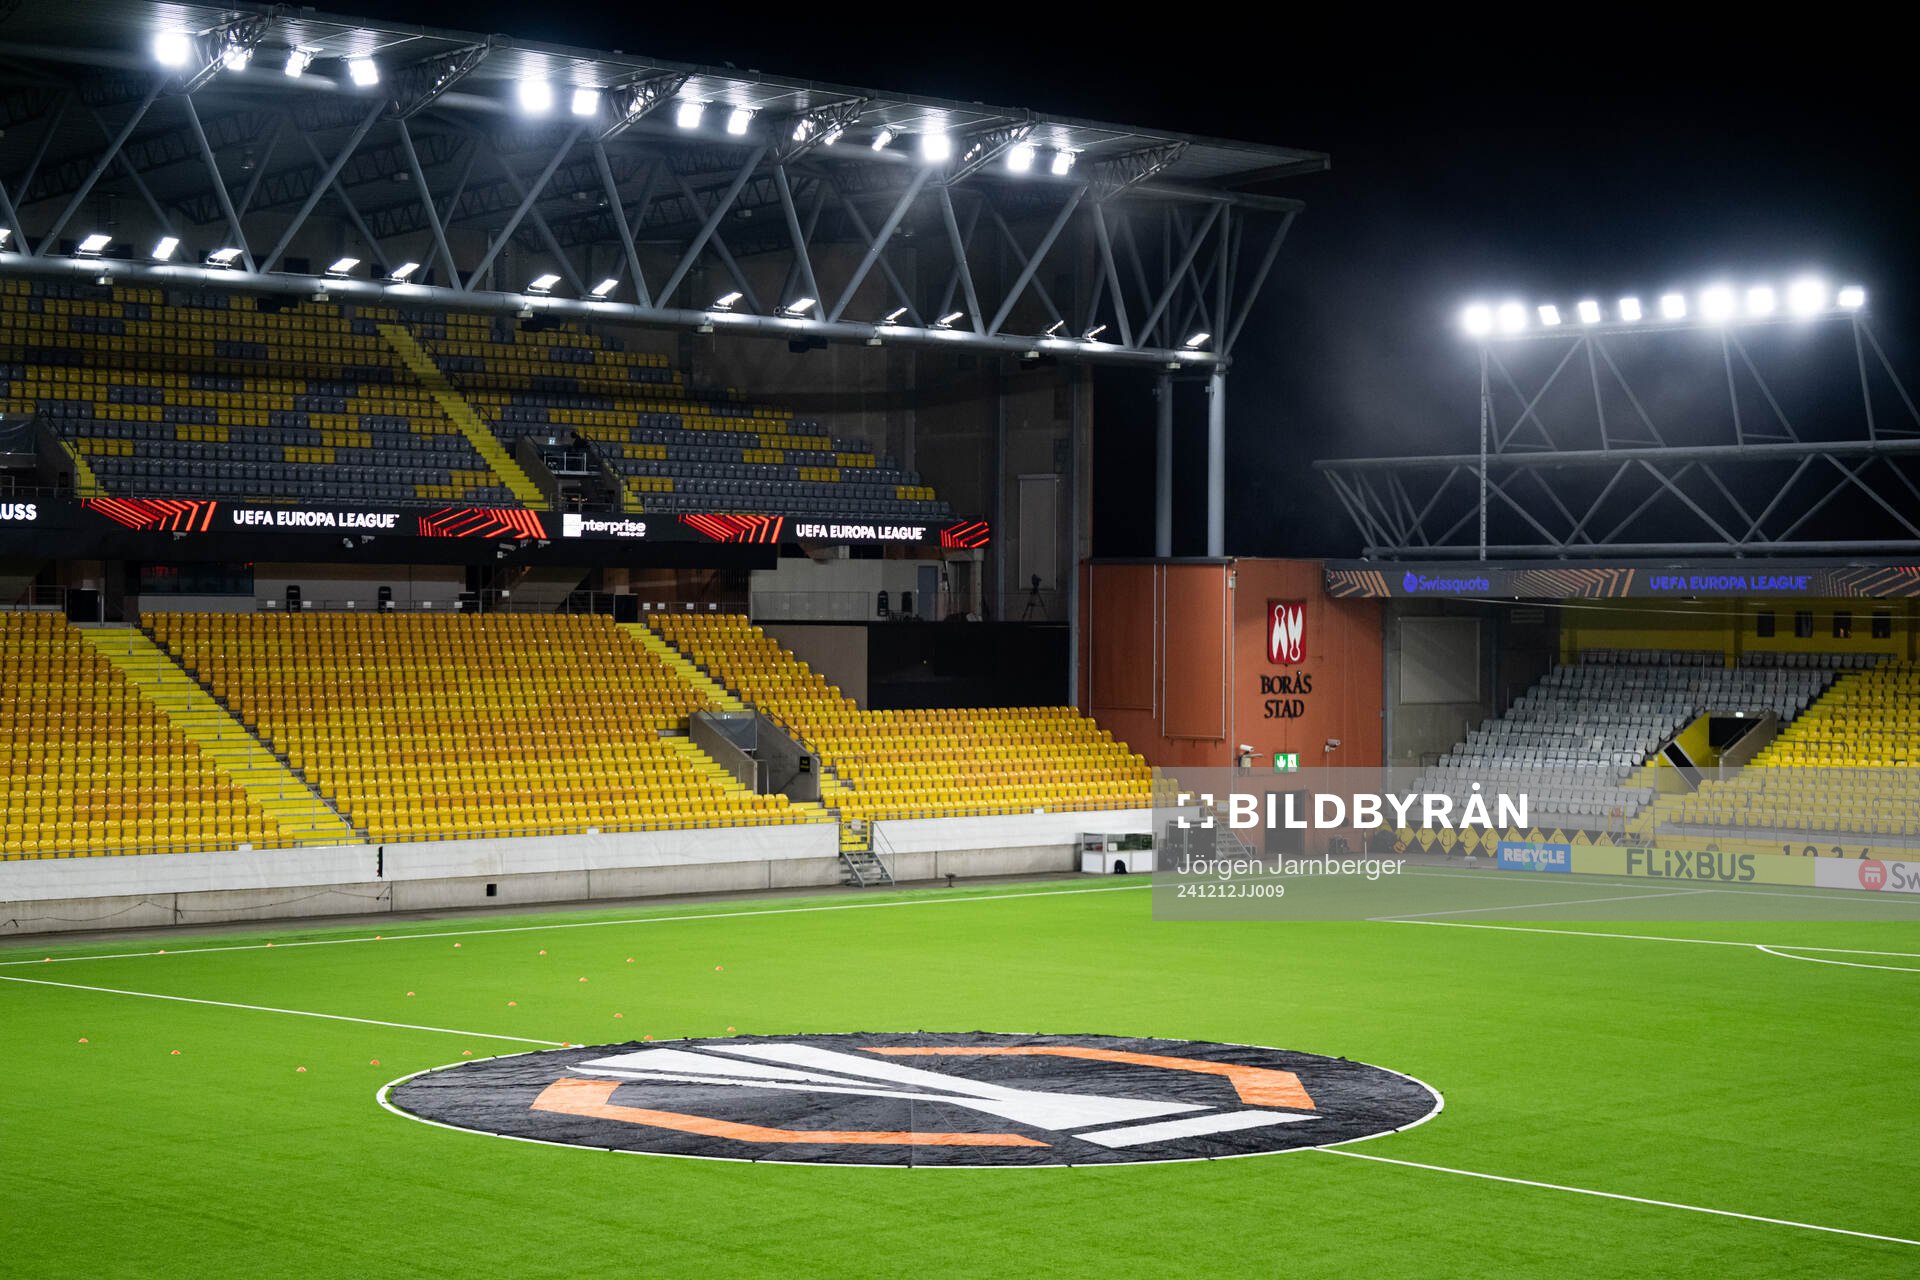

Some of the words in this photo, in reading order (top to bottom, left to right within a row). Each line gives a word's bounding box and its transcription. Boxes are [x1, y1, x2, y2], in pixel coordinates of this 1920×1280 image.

[0, 503, 37, 520] USS
[233, 510, 274, 525] UEFA
[277, 511, 336, 527] EUROPA
[338, 513, 396, 528] LEAGUE
[564, 515, 646, 535] nterprise
[796, 524, 828, 538] UEFA
[830, 525, 876, 539] EUROPA
[878, 526, 923, 540] LEAGUE
[1418, 575, 1489, 593] Swissquote
[1650, 576, 1687, 590] UEFA
[1690, 576, 1747, 590] EUROPA
[1750, 576, 1808, 590] LEAGUE
[1260, 671, 1312, 695] BORÅS
[1264, 700, 1304, 719] STAD
[1503, 848, 1566, 865] RECYCLE
